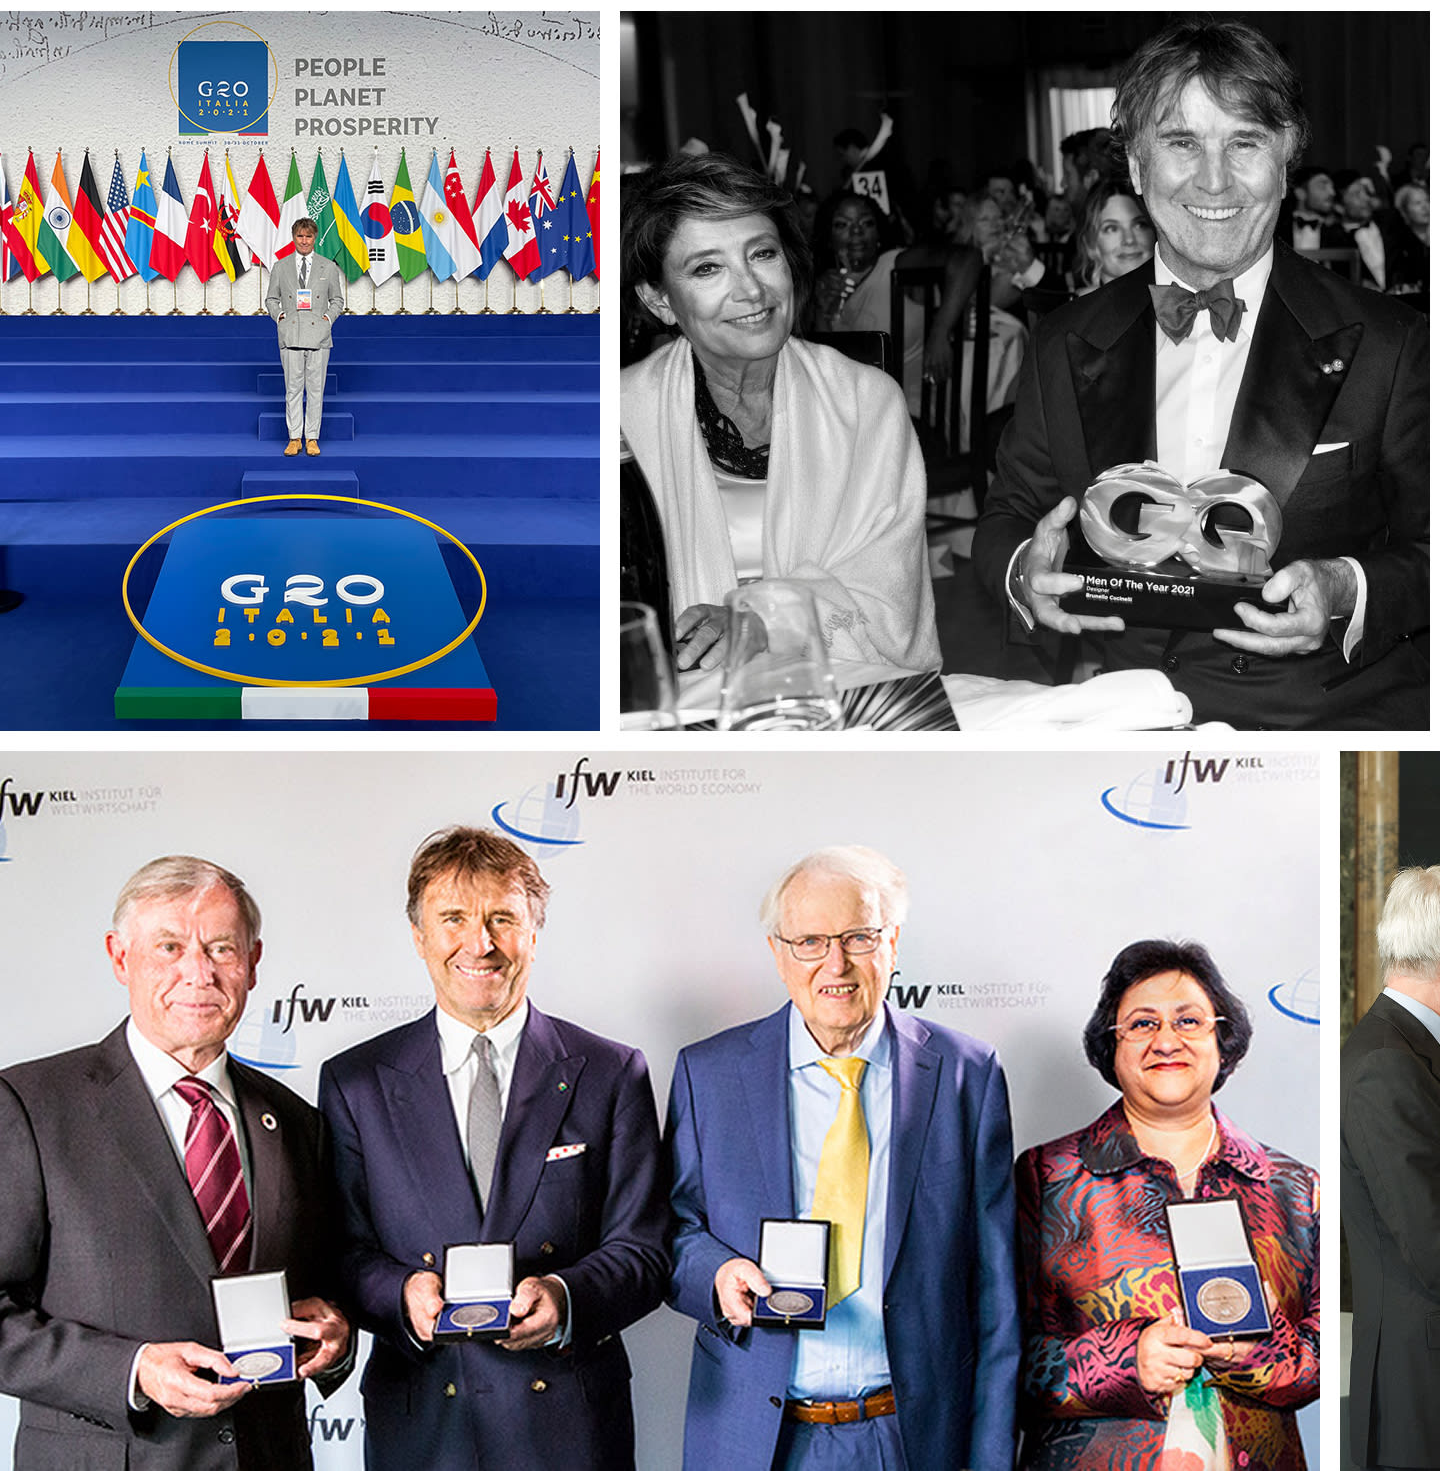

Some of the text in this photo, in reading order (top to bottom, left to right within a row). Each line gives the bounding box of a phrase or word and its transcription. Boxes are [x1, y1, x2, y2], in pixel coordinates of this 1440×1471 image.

[295, 57, 386, 77] PEOPLE
[198, 81, 249, 98] G20
[295, 88, 386, 107] PLANET
[295, 117, 439, 136] PROSPERITY
[1080, 460, 1283, 578] GQ
[221, 574, 385, 606] G20
[1086, 576, 1107, 586] Men
[1110, 578, 1123, 587] Of
[1125, 579, 1143, 590] The
[1146, 582, 1169, 592] Year
[1171, 585, 1195, 595] 2021
[218, 608, 391, 623] ITALIA
[1236, 758, 1264, 768] KIEL
[627, 770, 656, 781] KIEL
[660, 769, 721, 781] INSTITUTE
[723, 768, 747, 780] FOR
[50, 790, 77, 802] KIEL
[80, 788, 134, 801] INSTITUT
[628, 783, 762, 795] THE WORLD ECONOMY
[51, 801, 157, 816] WELTWIRTSCHAFT
[937, 984, 965, 995] KIEL
[969, 983, 1024, 994] INSTITUT
[342, 997, 370, 1008] KIEL
[937, 996, 1047, 1008] WELTWIRTSCHAFT
